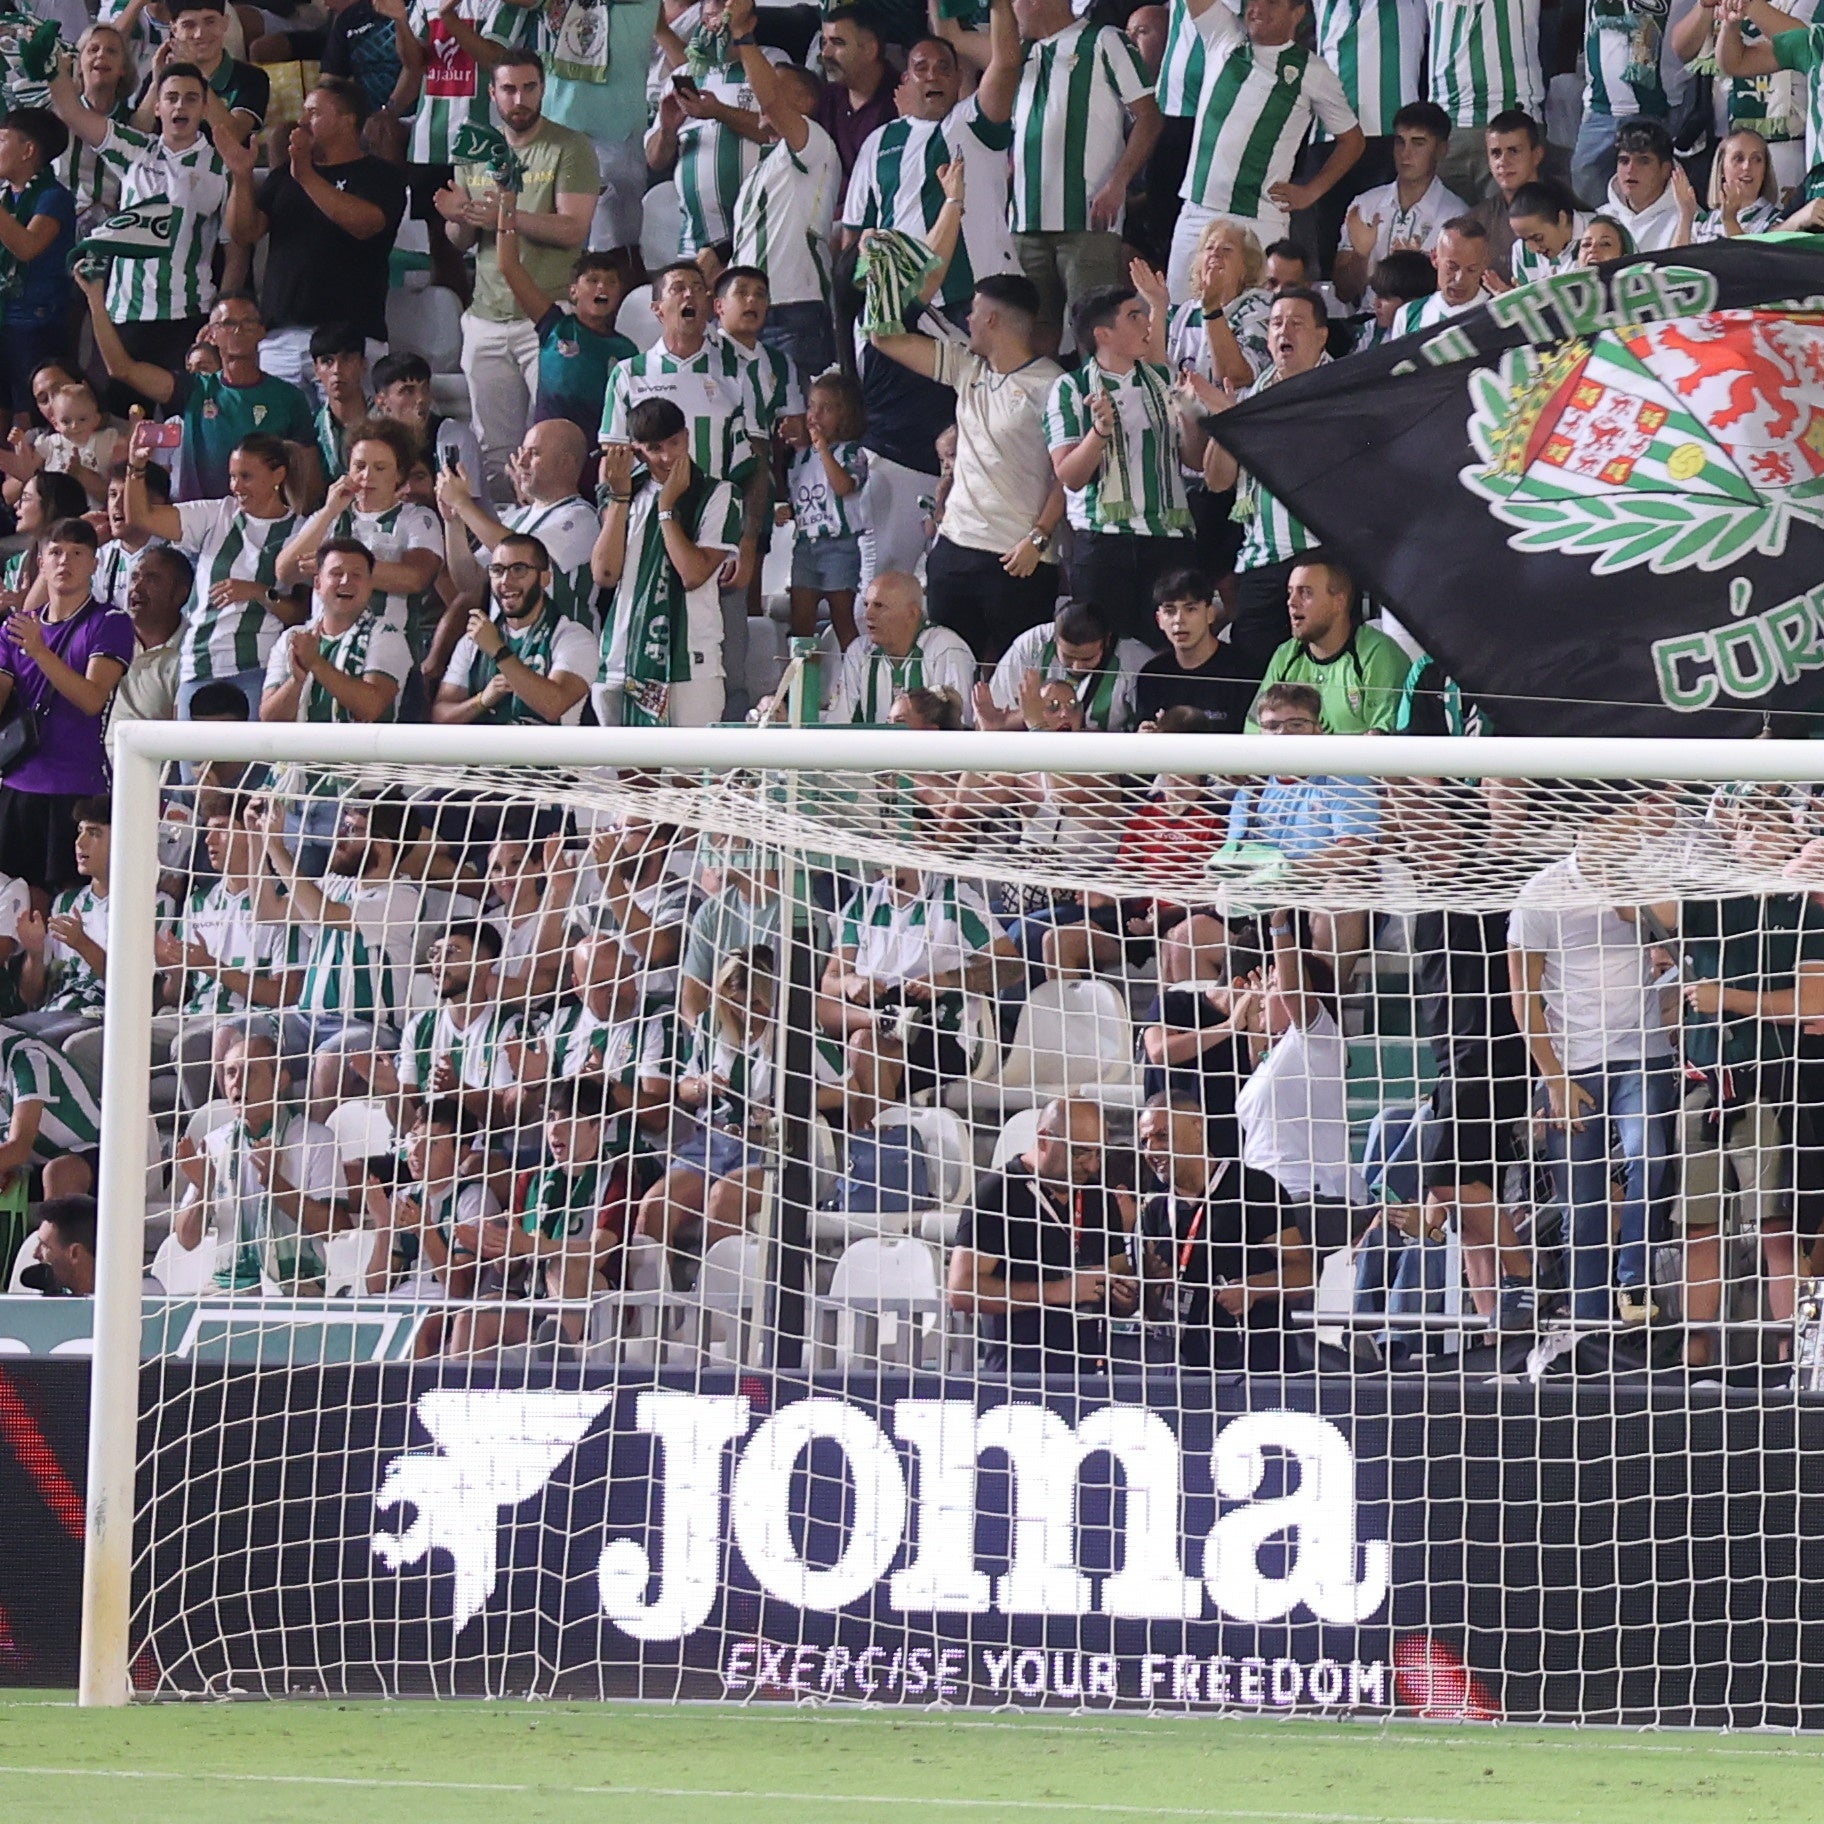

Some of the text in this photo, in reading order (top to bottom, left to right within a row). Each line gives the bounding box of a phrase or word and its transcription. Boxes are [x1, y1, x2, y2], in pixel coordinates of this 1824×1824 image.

[597, 1389, 1391, 1643] Joma
[723, 1643, 1387, 1710] EXERCISE YOUR FREEDOM
